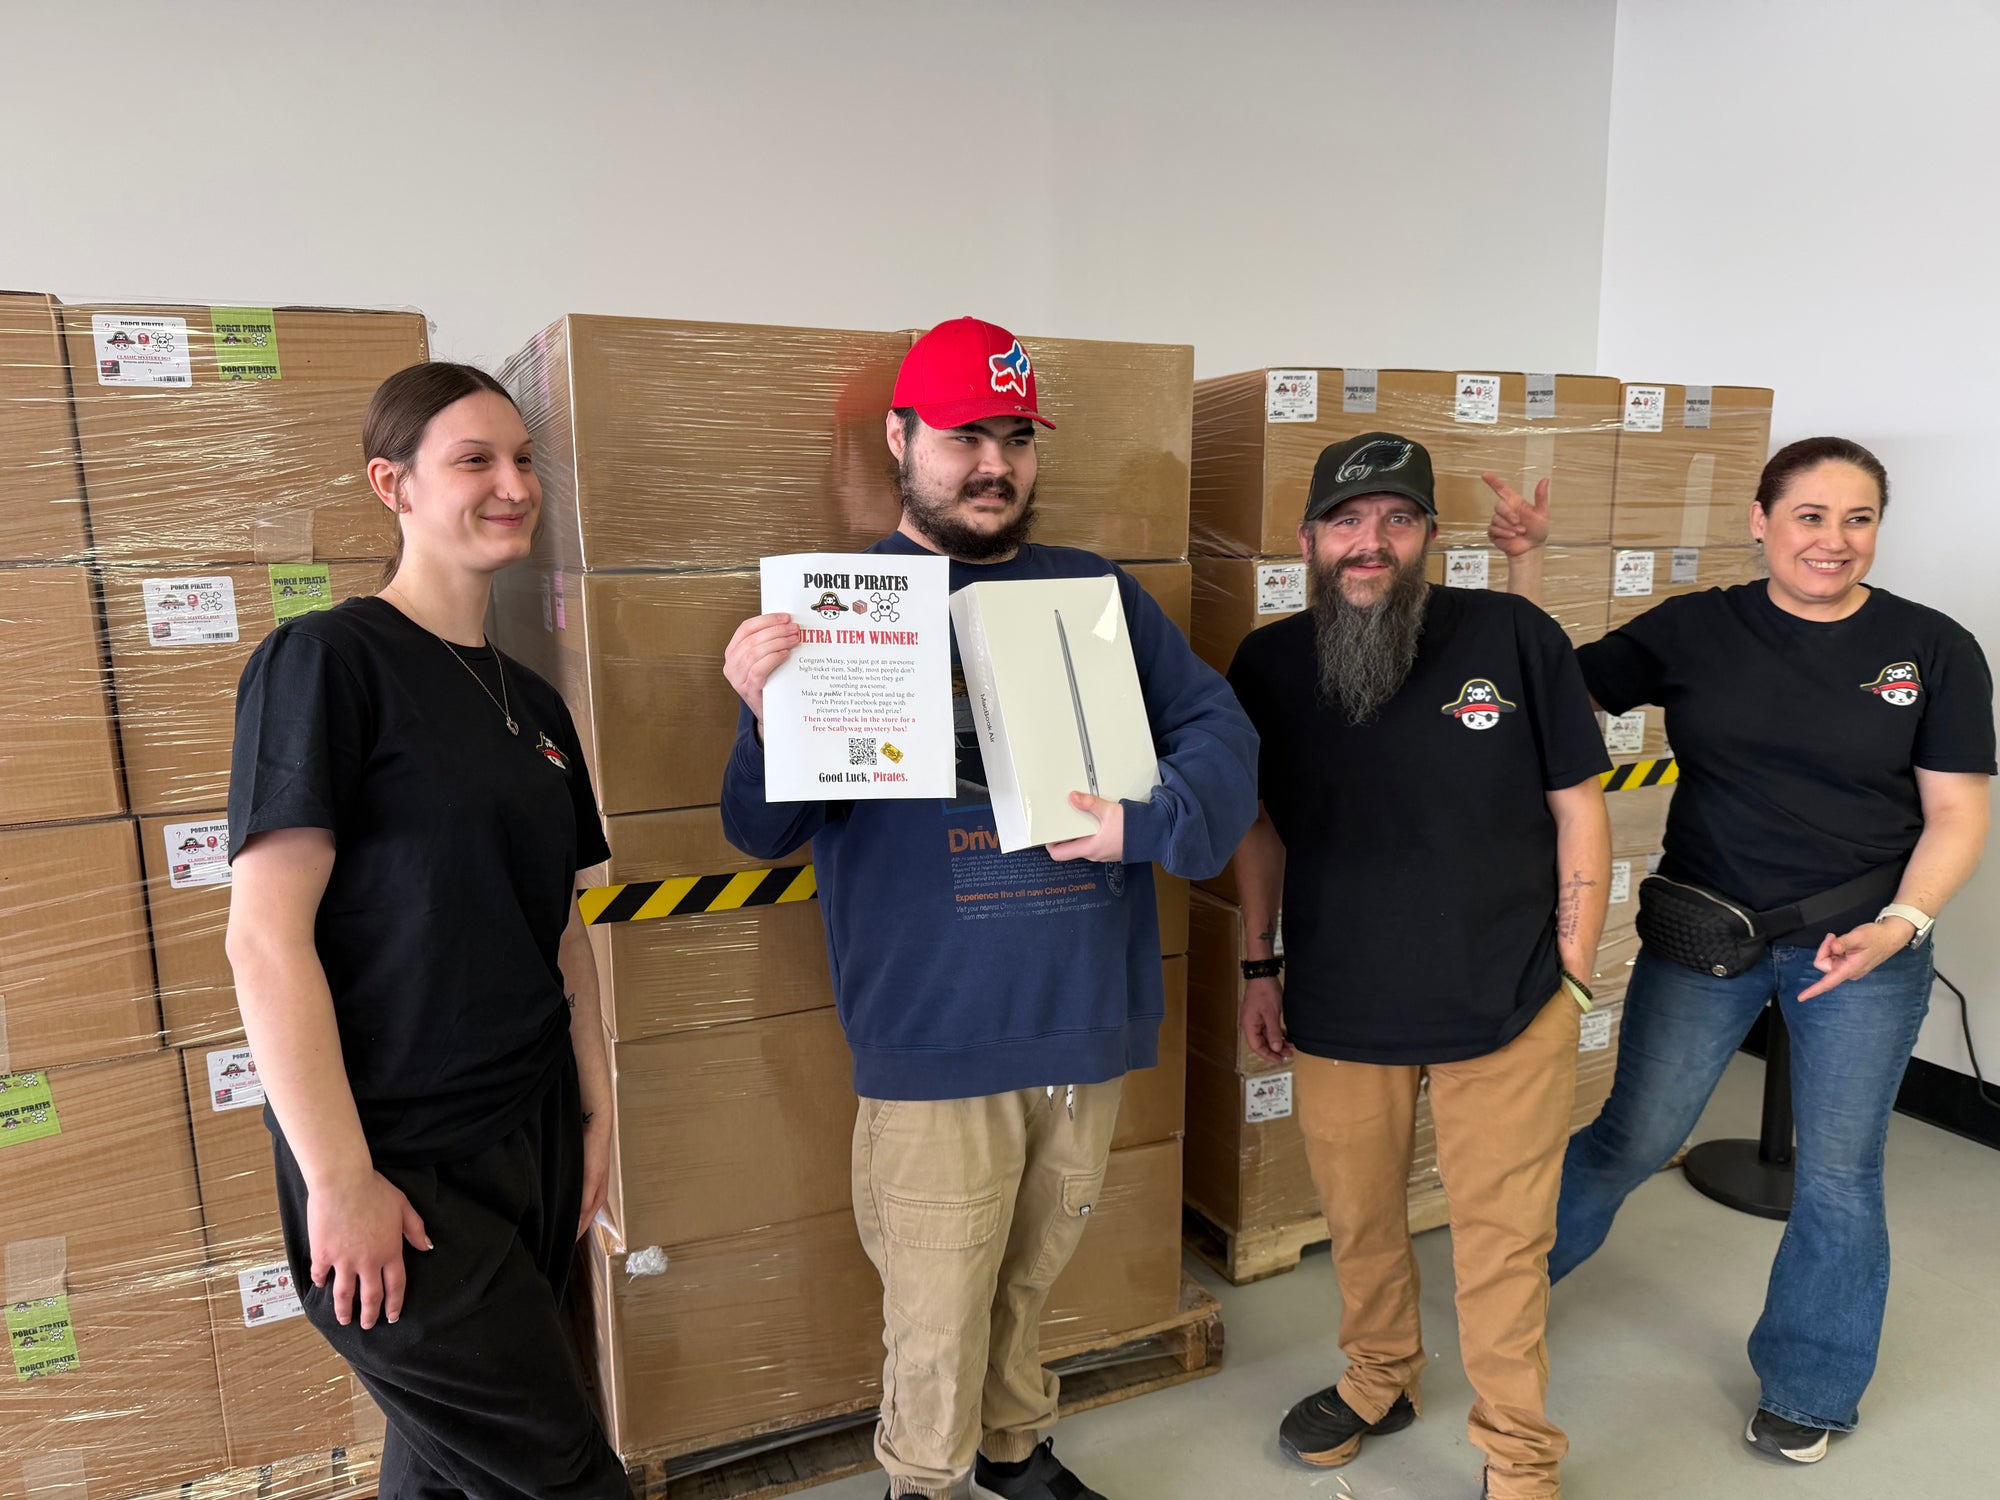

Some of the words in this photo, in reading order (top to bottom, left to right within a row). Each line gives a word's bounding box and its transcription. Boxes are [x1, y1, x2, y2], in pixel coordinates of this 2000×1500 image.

[216, 325, 241, 333] PORCH
[242, 324, 272, 333] PIRATES
[222, 366, 246, 374] PORCH
[248, 366, 277, 374] PIRATES
[274, 578, 298, 586] PORCH
[298, 576, 326, 585] PIRATES
[803, 573, 850, 590] PORCH
[854, 574, 908, 591] PIRATES
[836, 630, 865, 644] ITEM
[868, 630, 919, 645] WINNER!
[799, 656, 824, 664] Congrats
[826, 658, 846, 666] Matey,
[830, 682, 858, 690] something
[980, 693, 994, 732] MacBook
[988, 732, 997, 743] Air
[827, 724, 862, 734] Scallywag
[818, 772, 843, 783] Good
[846, 772, 870, 784] Luck,
[873, 771, 908, 783] Pirates.
[956, 892, 999, 902] Experience
[1001, 890, 1014, 899] the
[1015, 890, 1026, 898] all
[1045, 886, 1067, 895] Chevy
[1068, 882, 1097, 892] Corvette
[0, 1108, 20, 1119] ORCH
[20, 1100, 51, 1114] PIRATES
[12, 1327, 38, 1340] PORCH
[40, 1320, 69, 1333] PIRATES
[20, 1362, 45, 1374] PORCH
[46, 1354, 76, 1367] PIRATES
